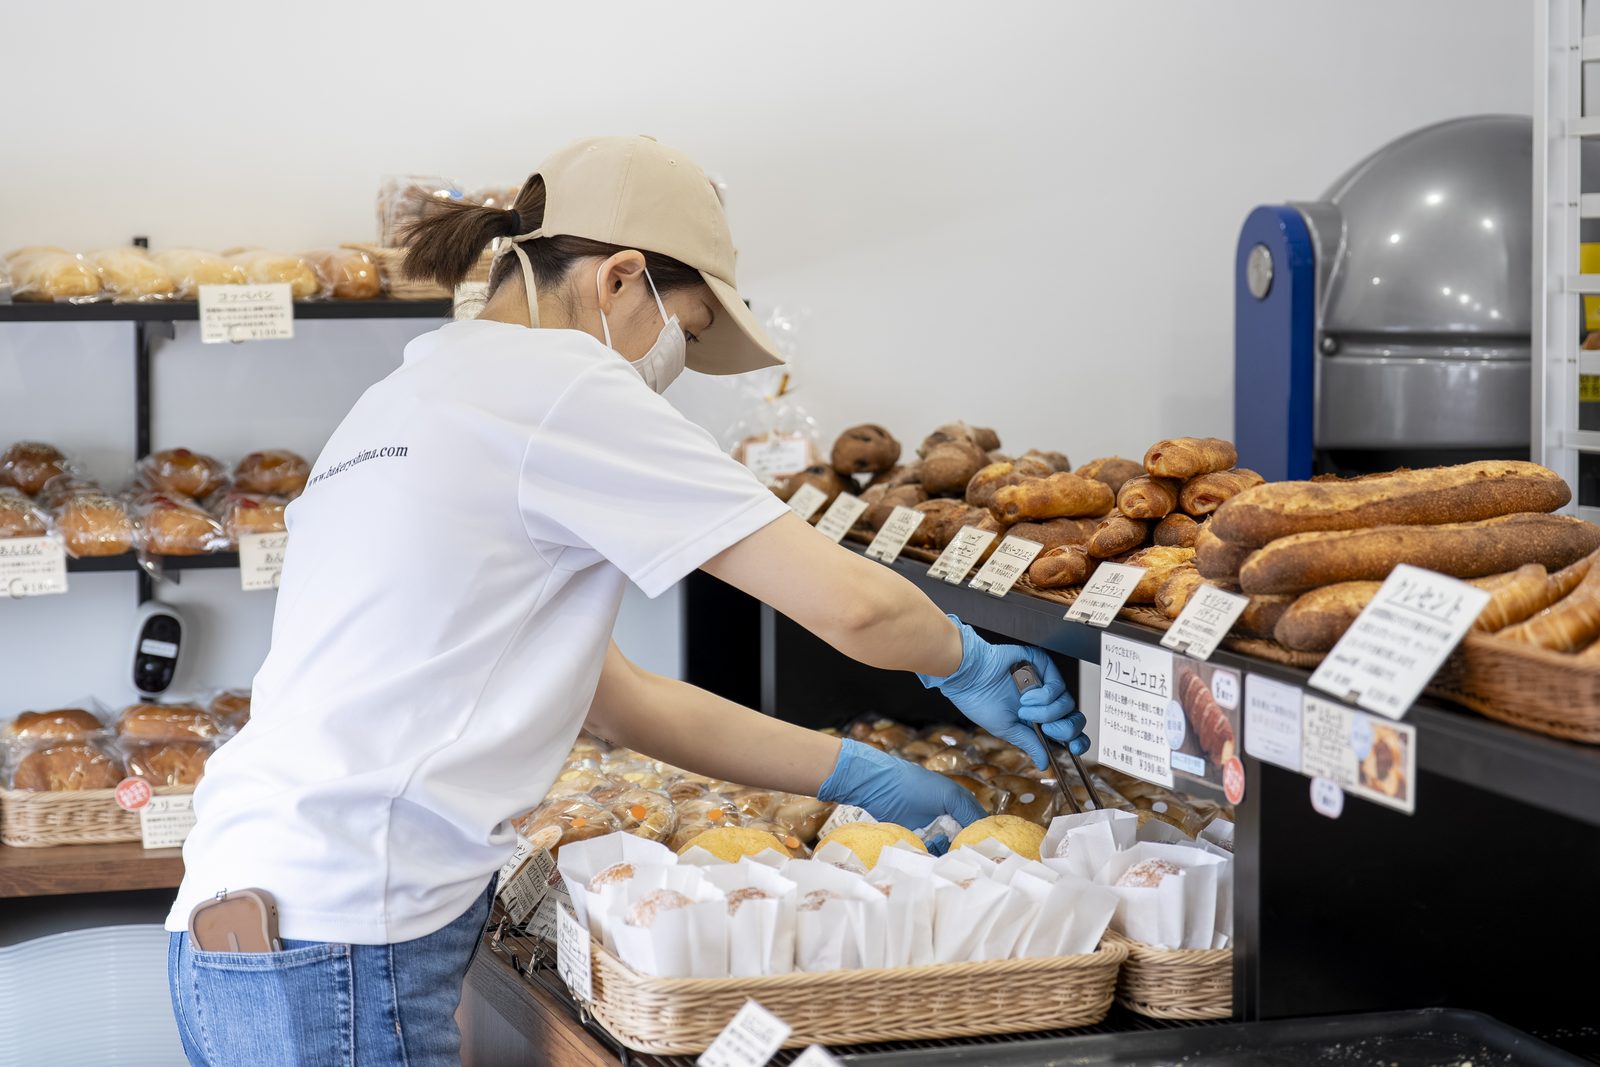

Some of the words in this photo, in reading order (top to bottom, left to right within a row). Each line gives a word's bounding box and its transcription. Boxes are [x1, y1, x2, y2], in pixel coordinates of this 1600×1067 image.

[219, 291, 273, 300] コッペパン
[308, 446, 408, 488] www.bakeryshima.com
[1090, 583, 1127, 597] チーズフランス
[1388, 579, 1464, 622] クレセント
[1106, 659, 1168, 697] クリームコロネ
